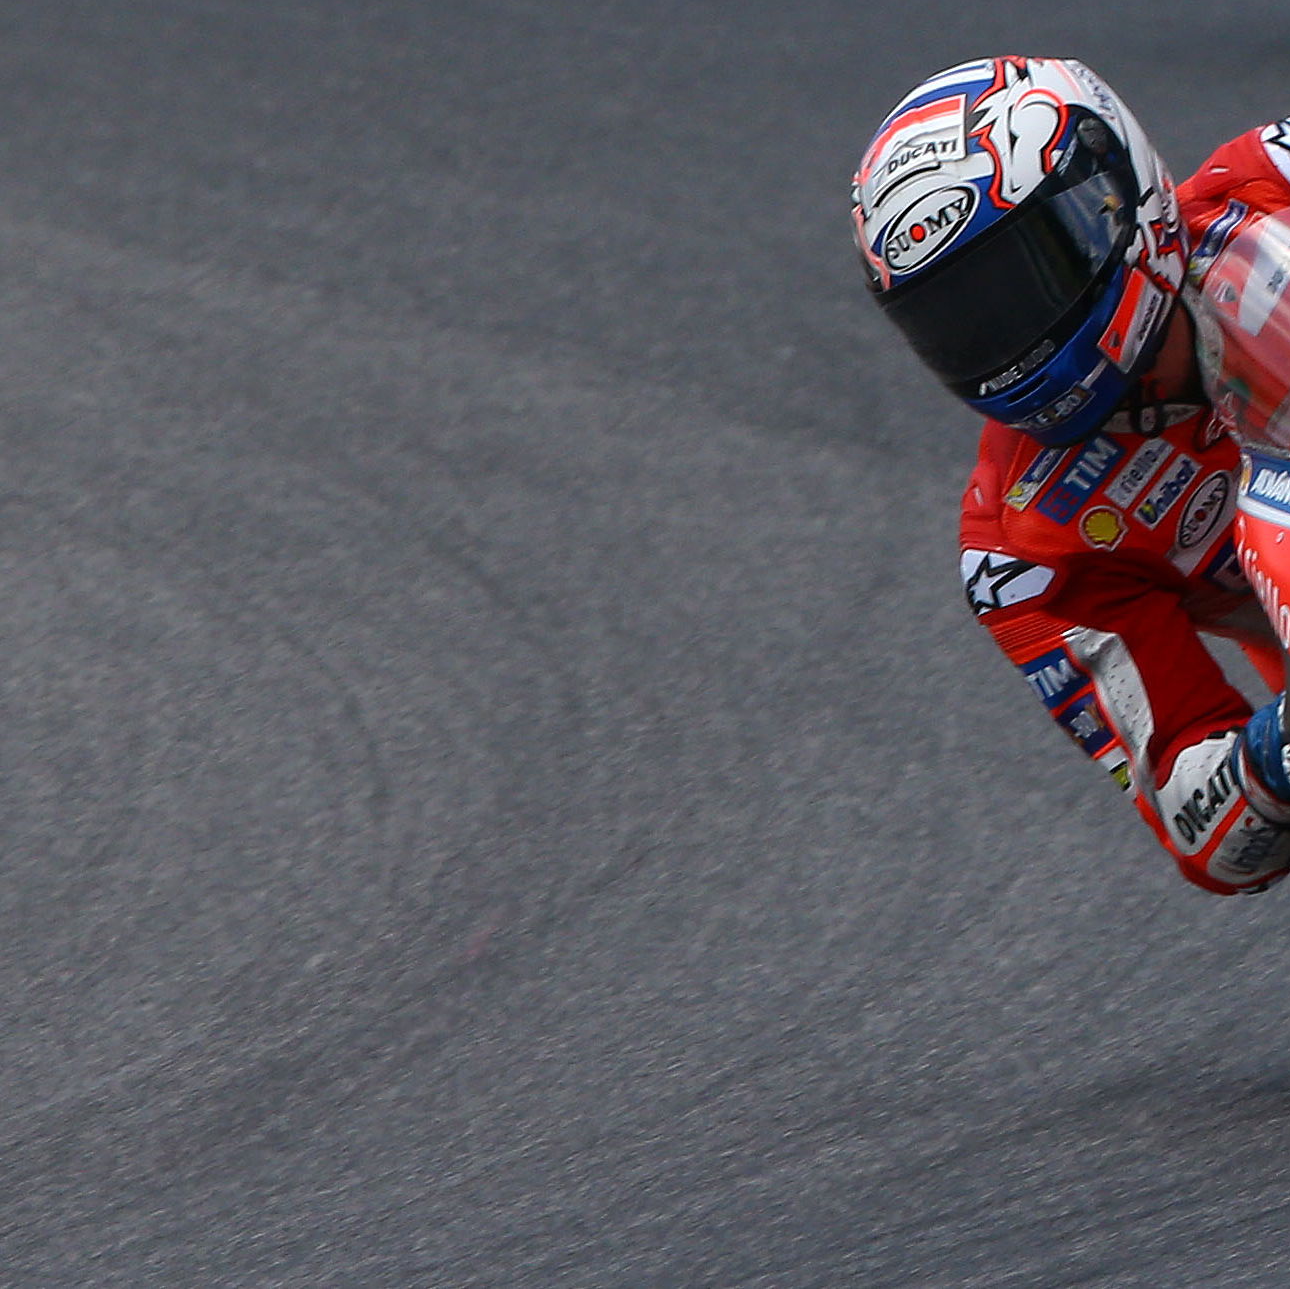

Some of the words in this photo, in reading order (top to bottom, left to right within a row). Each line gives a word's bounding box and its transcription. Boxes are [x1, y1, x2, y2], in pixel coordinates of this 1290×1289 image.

[887, 137, 960, 175] DUCATI
[886, 195, 970, 260] SUOMY
[1065, 435, 1119, 491] TIM
